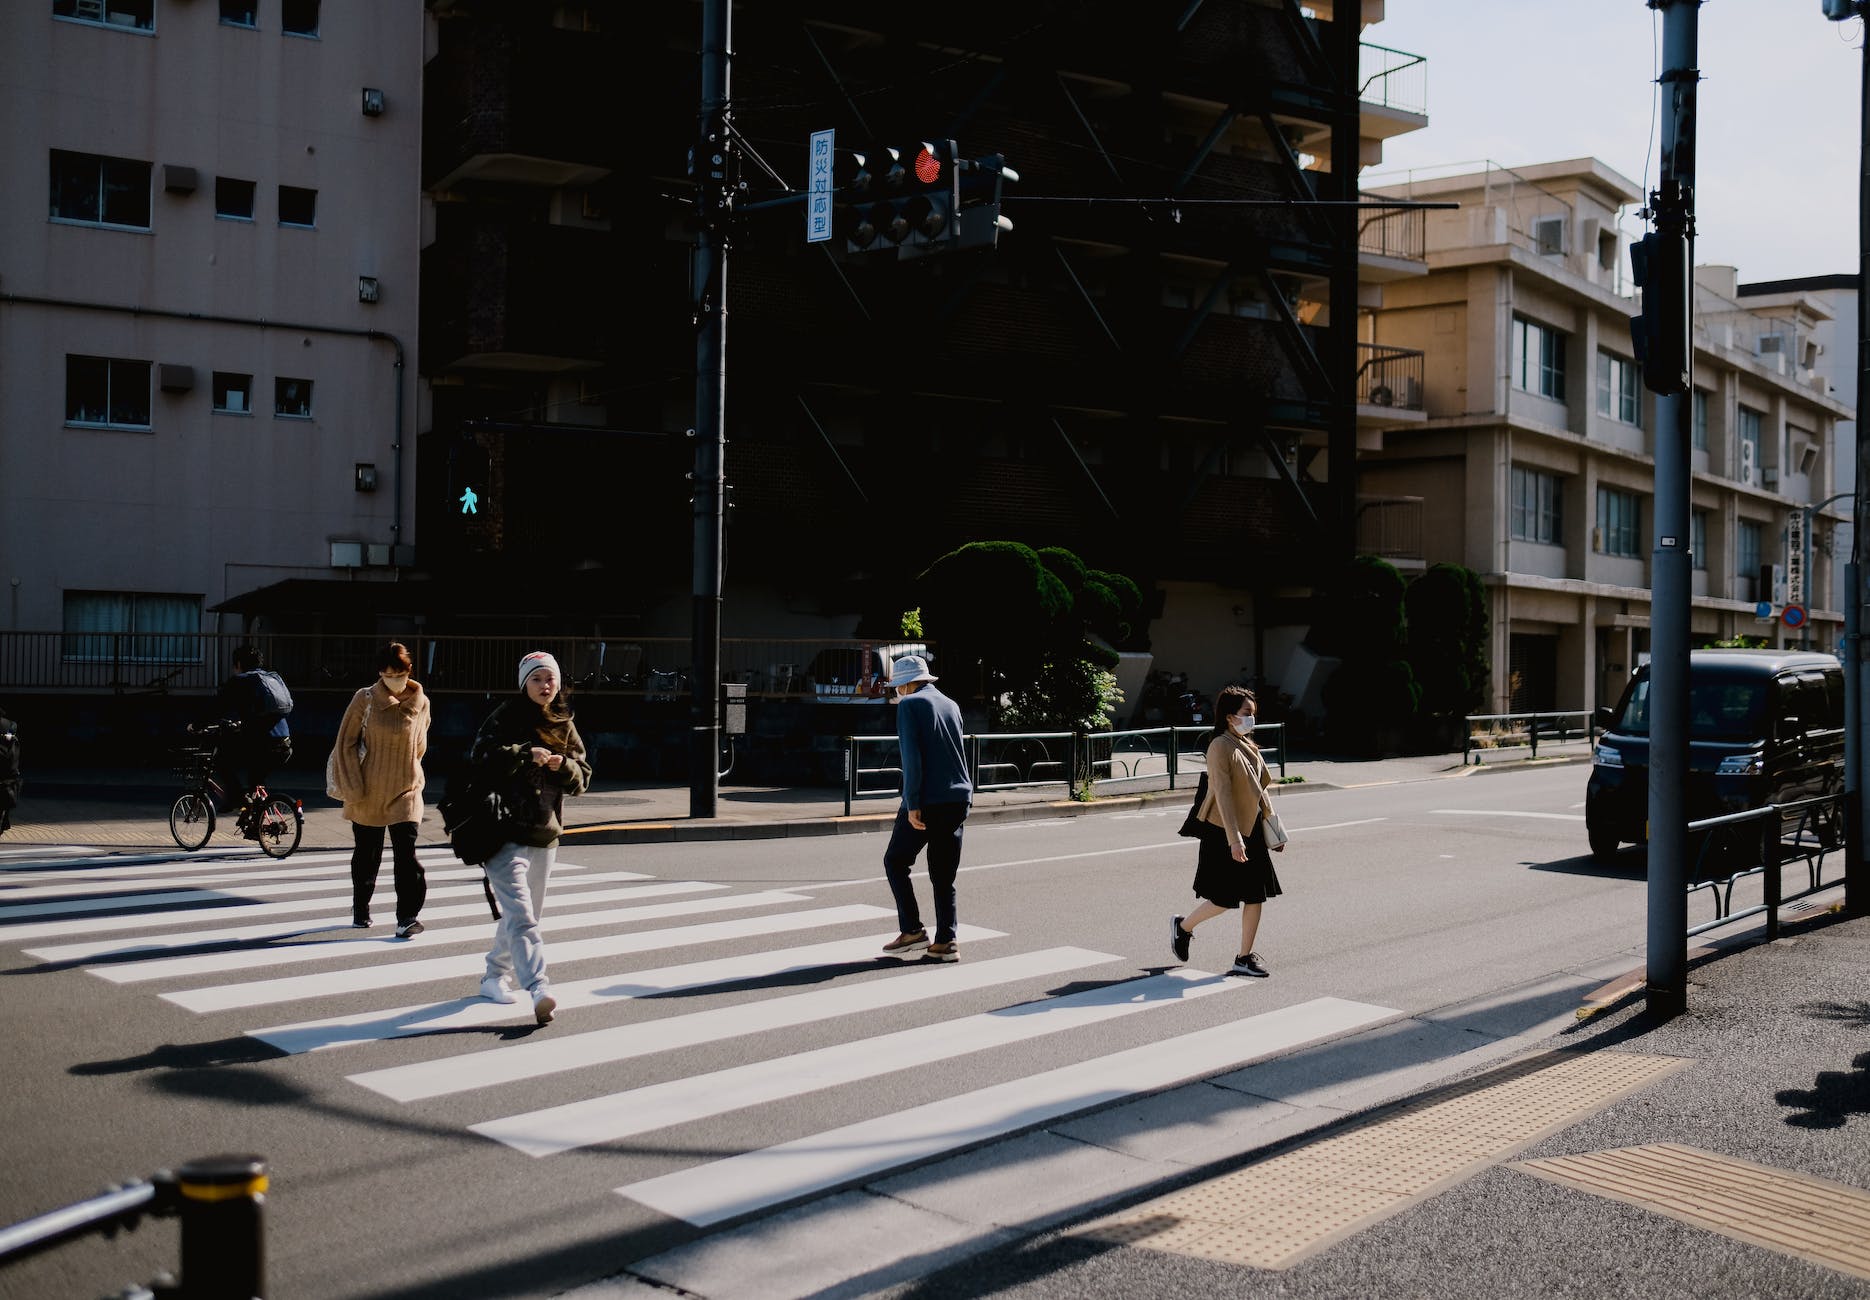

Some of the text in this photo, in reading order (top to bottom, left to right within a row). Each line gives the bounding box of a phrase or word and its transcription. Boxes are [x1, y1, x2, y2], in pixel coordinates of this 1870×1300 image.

[814, 138, 829, 233] 防災対応型
